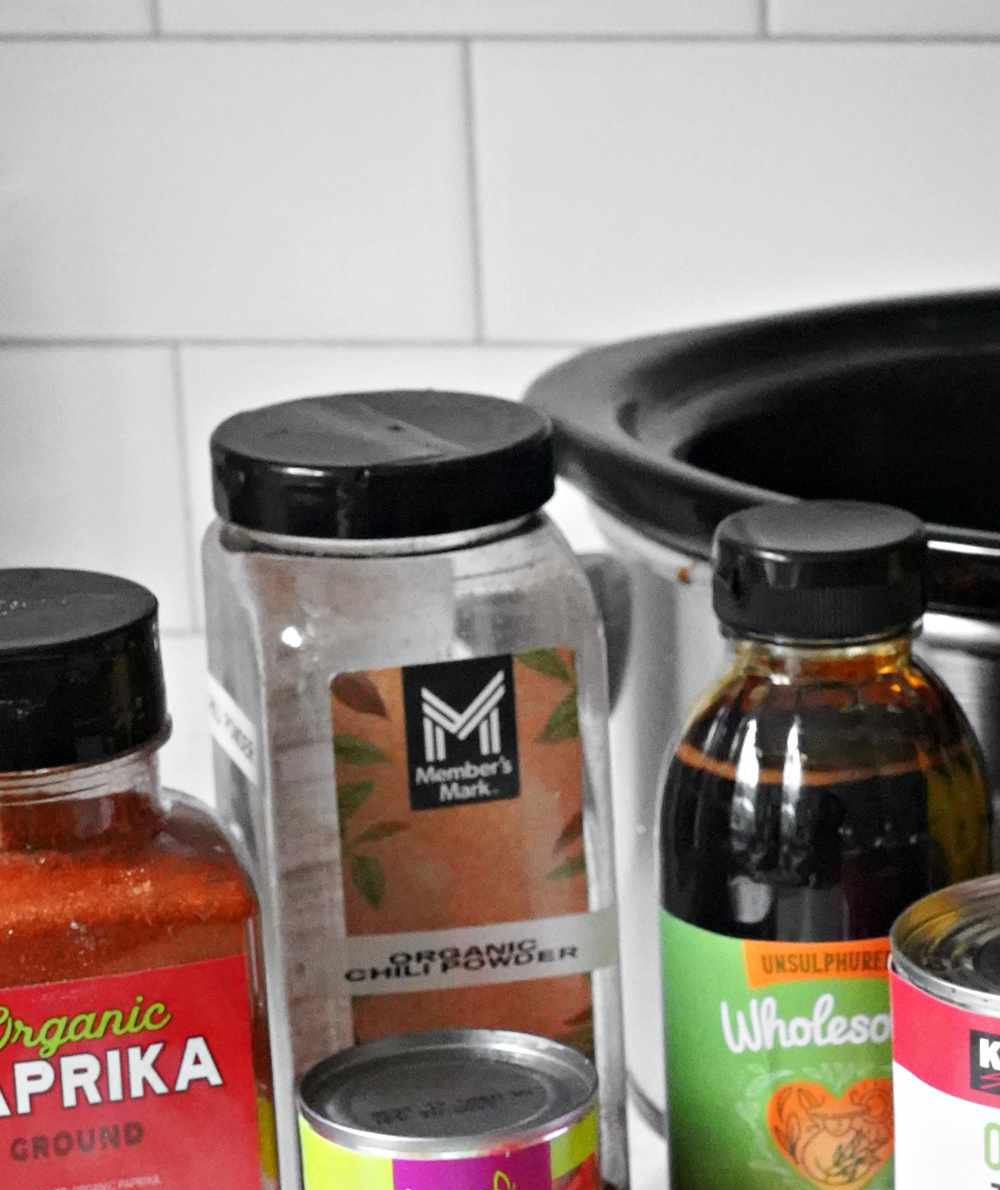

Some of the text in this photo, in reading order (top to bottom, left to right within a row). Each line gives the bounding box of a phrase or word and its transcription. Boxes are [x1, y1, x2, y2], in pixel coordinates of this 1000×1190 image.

[415, 756, 513, 785] Member's
[344, 946, 579, 982] CHILI POWDER
[389, 938, 538, 967] ORGANIC
[10, 1121, 144, 1163] GROUND
